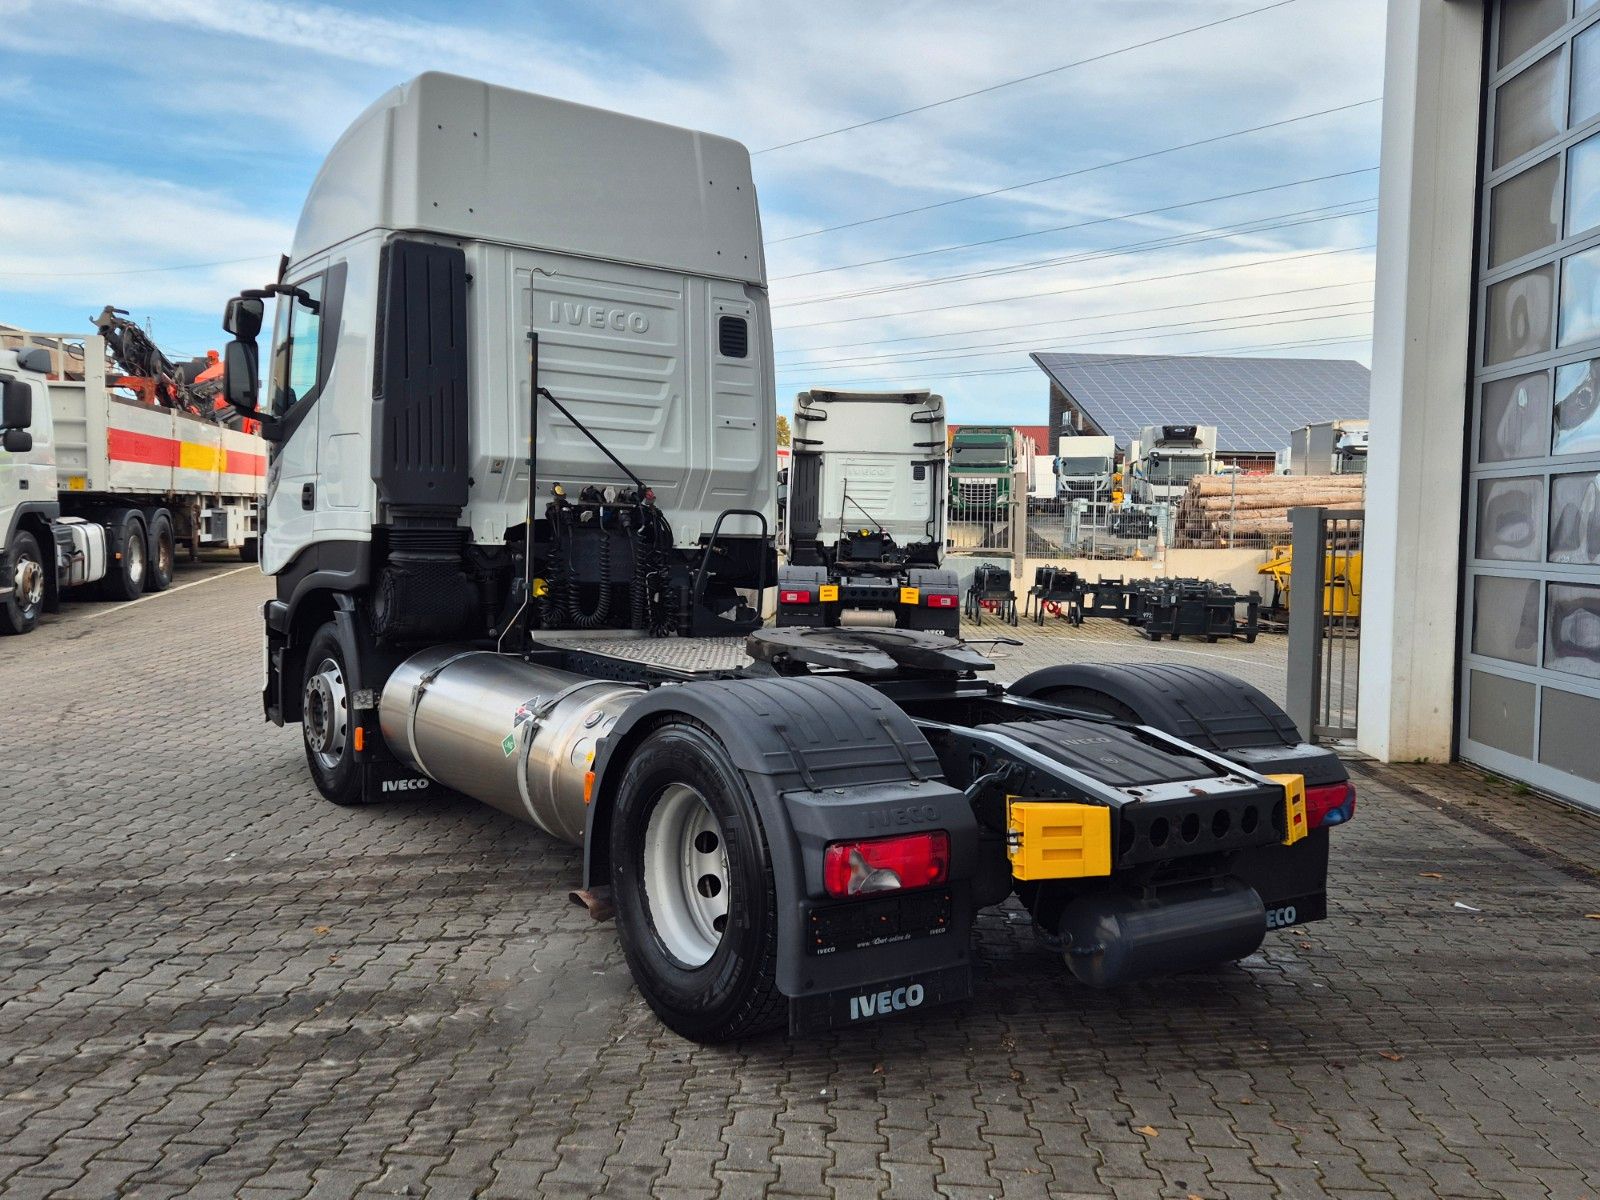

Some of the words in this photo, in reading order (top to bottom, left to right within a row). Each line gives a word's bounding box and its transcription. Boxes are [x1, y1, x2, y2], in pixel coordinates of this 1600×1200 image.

[550, 301, 650, 334] IVECO
[1059, 737, 1112, 746] IVECO
[382, 778, 429, 792] IVECO
[866, 805, 940, 829] IVECO
[1266, 906, 1297, 928] ECO
[816, 946, 836, 955] IVECO
[850, 983, 925, 1020] IVECO
